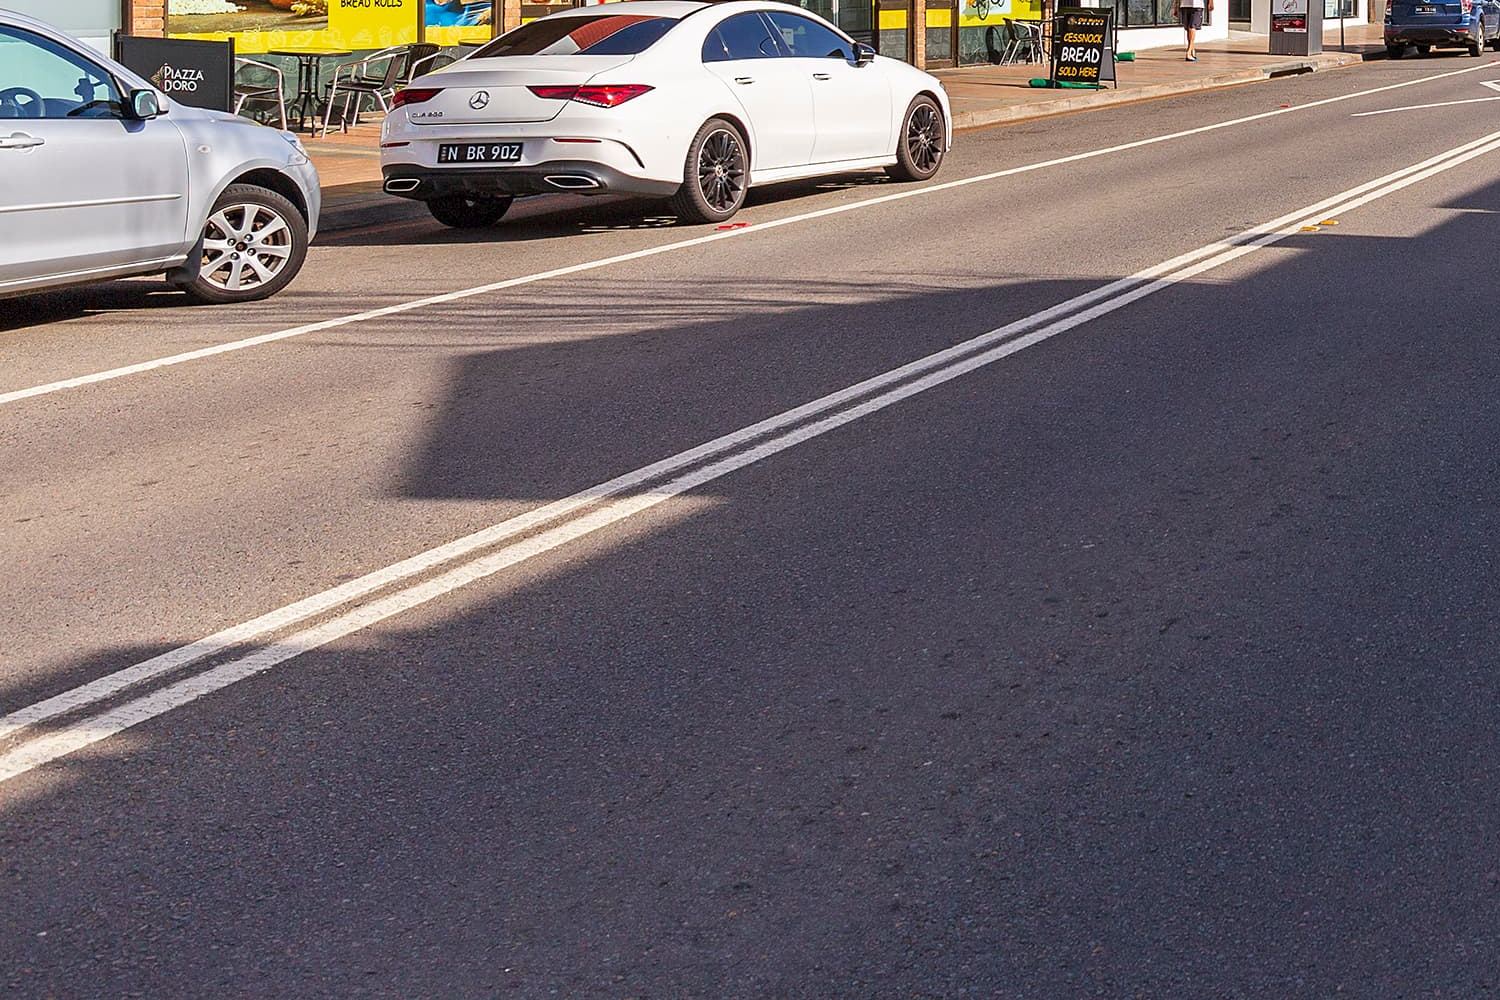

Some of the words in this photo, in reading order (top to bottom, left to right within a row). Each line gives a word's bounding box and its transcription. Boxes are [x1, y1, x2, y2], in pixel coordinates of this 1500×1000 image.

[1063, 33, 1103, 44] CESSNOCK
[1061, 46, 1100, 63] BREAD
[164, 66, 205, 81] PIAZZA
[1057, 66, 1077, 77] SOLD
[1078, 67, 1098, 78] HERE
[466, 146, 486, 160] BR
